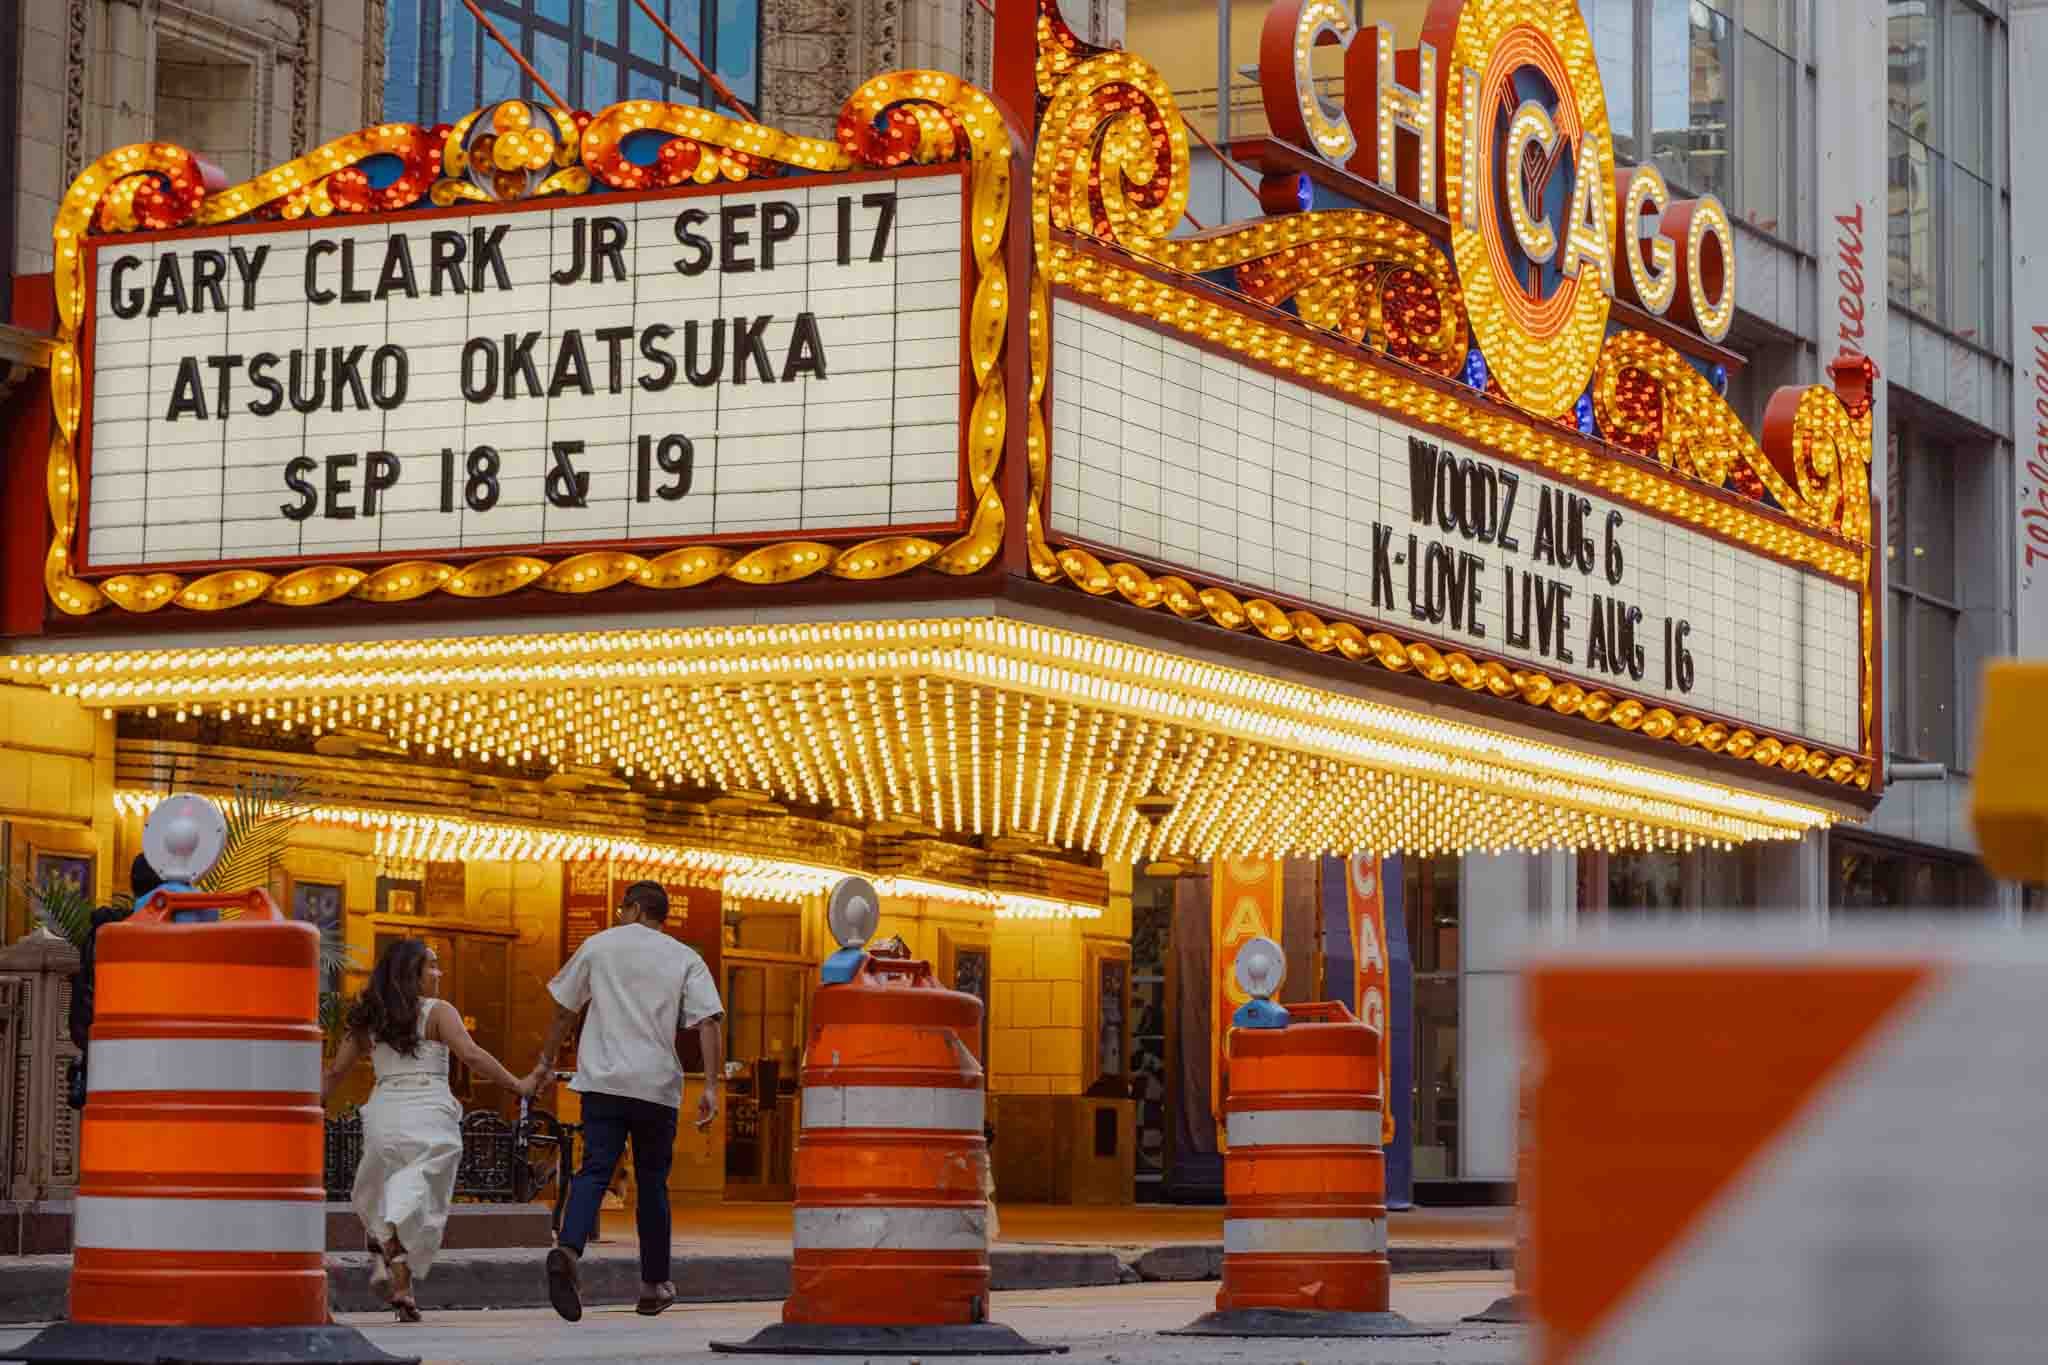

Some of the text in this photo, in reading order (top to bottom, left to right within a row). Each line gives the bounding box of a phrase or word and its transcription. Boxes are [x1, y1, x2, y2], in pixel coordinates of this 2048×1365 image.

[1292, 0, 1736, 342] CHICAGO
[110, 191, 897, 319] GARY CLARK JR SEP 17
[166, 312, 827, 422] ATSUKO OKATSUKA
[280, 433, 694, 521] SEP 18 & 19
[1408, 435, 1623, 586] WOODZ AUG 6
[1371, 521, 1695, 693] K-LOVE LIVE AUG 16
